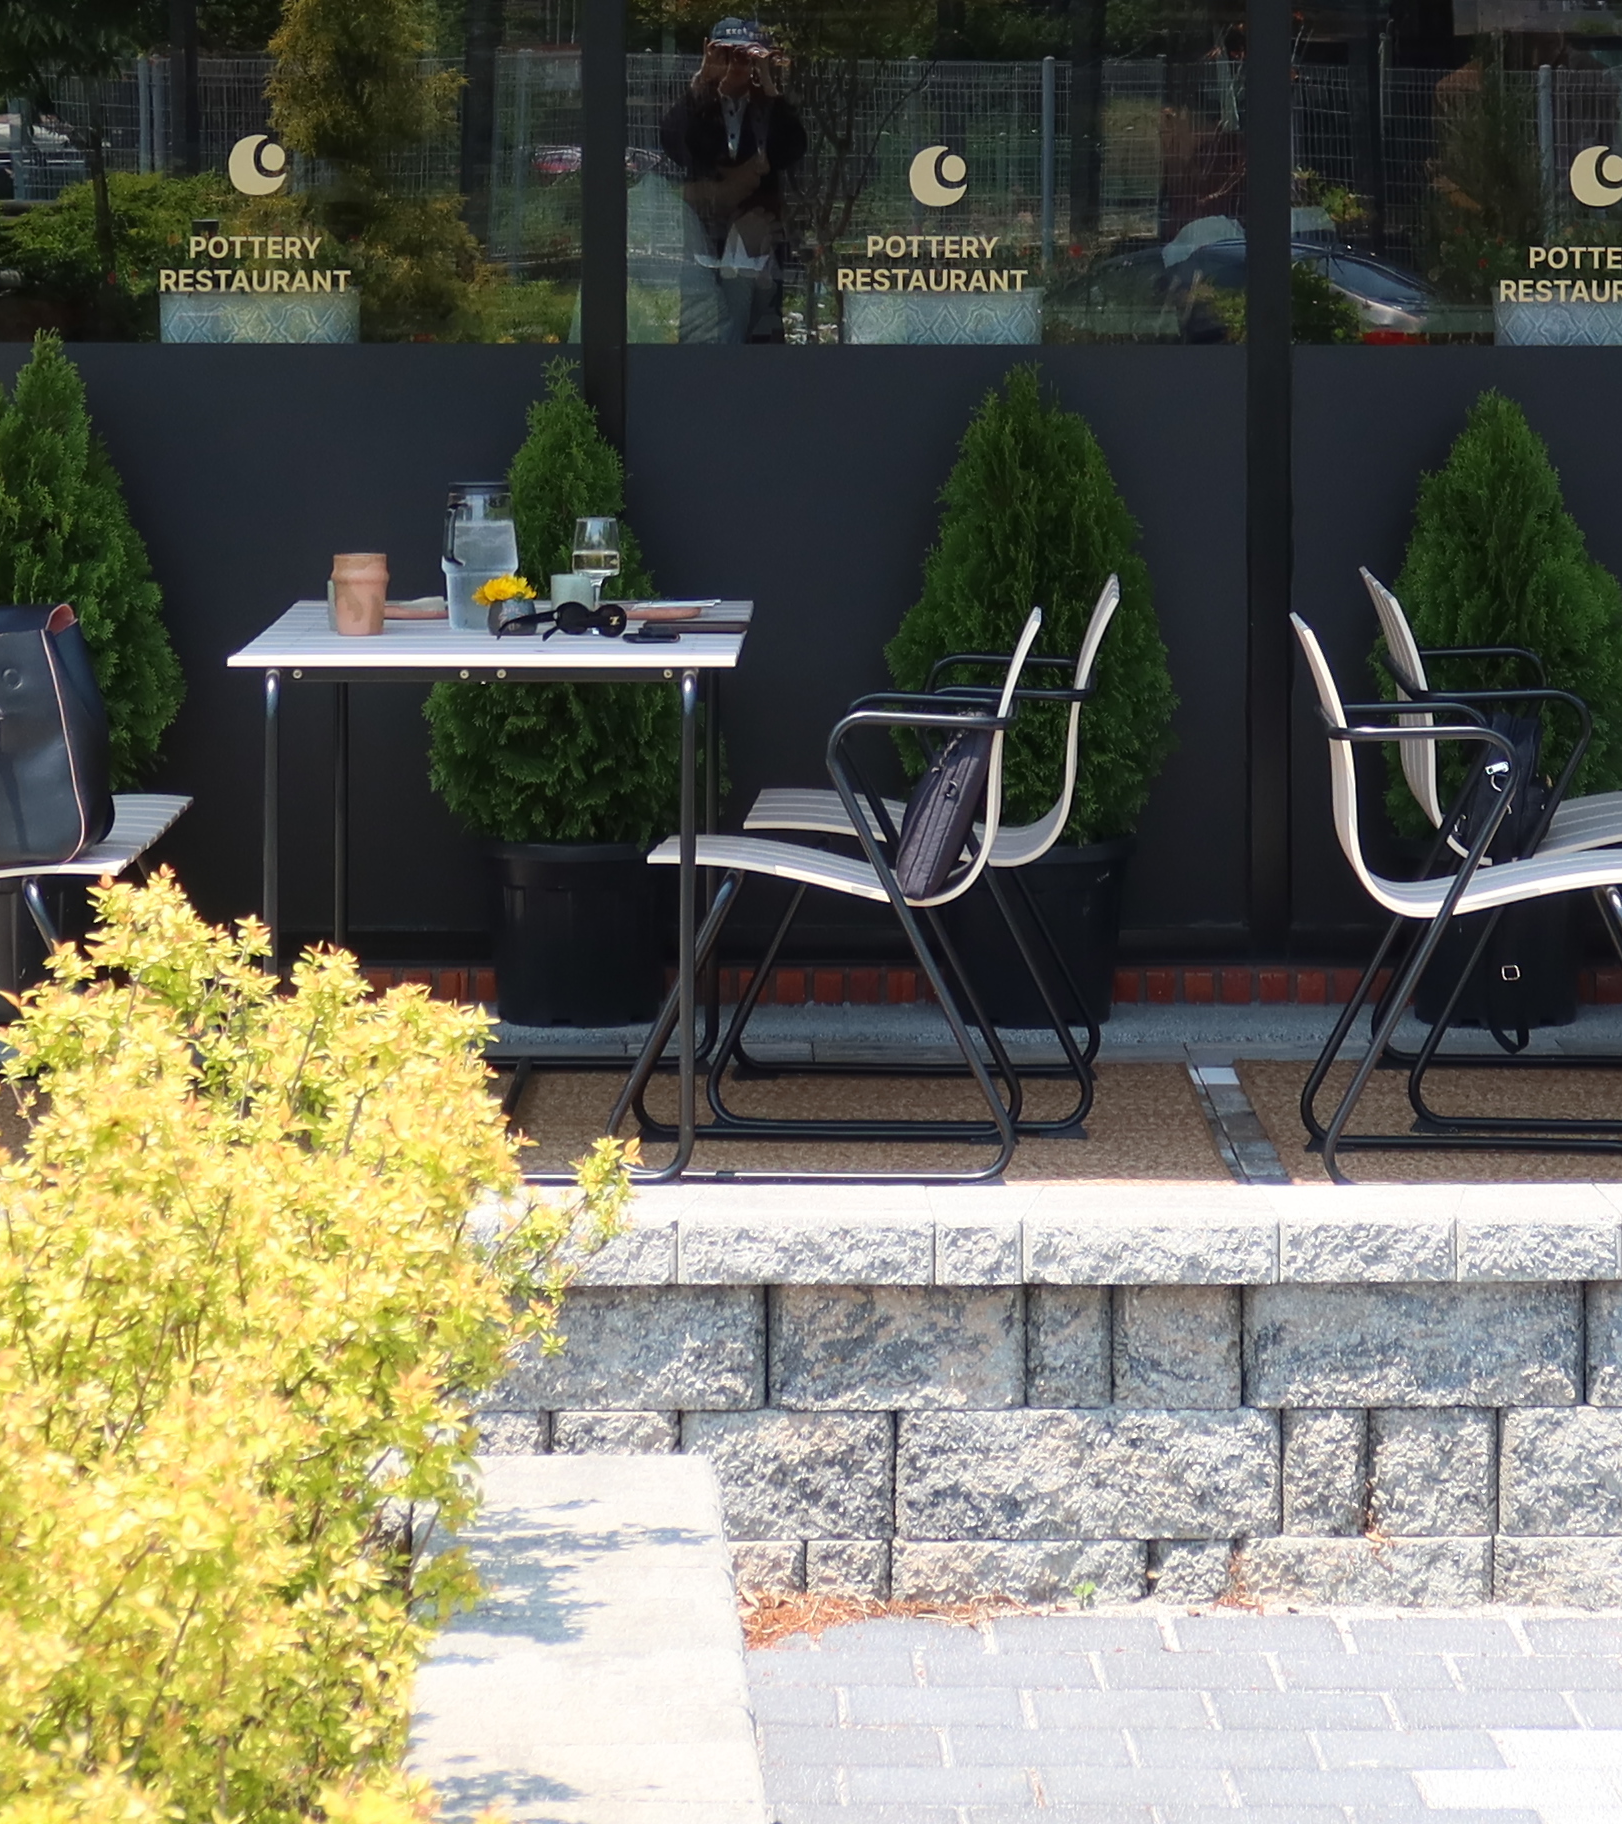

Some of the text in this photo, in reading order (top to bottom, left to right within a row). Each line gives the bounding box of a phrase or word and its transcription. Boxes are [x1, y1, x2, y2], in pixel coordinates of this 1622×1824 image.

[189, 235, 322, 260] POTTERY
[866, 234, 1000, 259] POTTERY
[159, 269, 351, 294] RESTAURANT
[837, 268, 1028, 293] RESTAURANT
